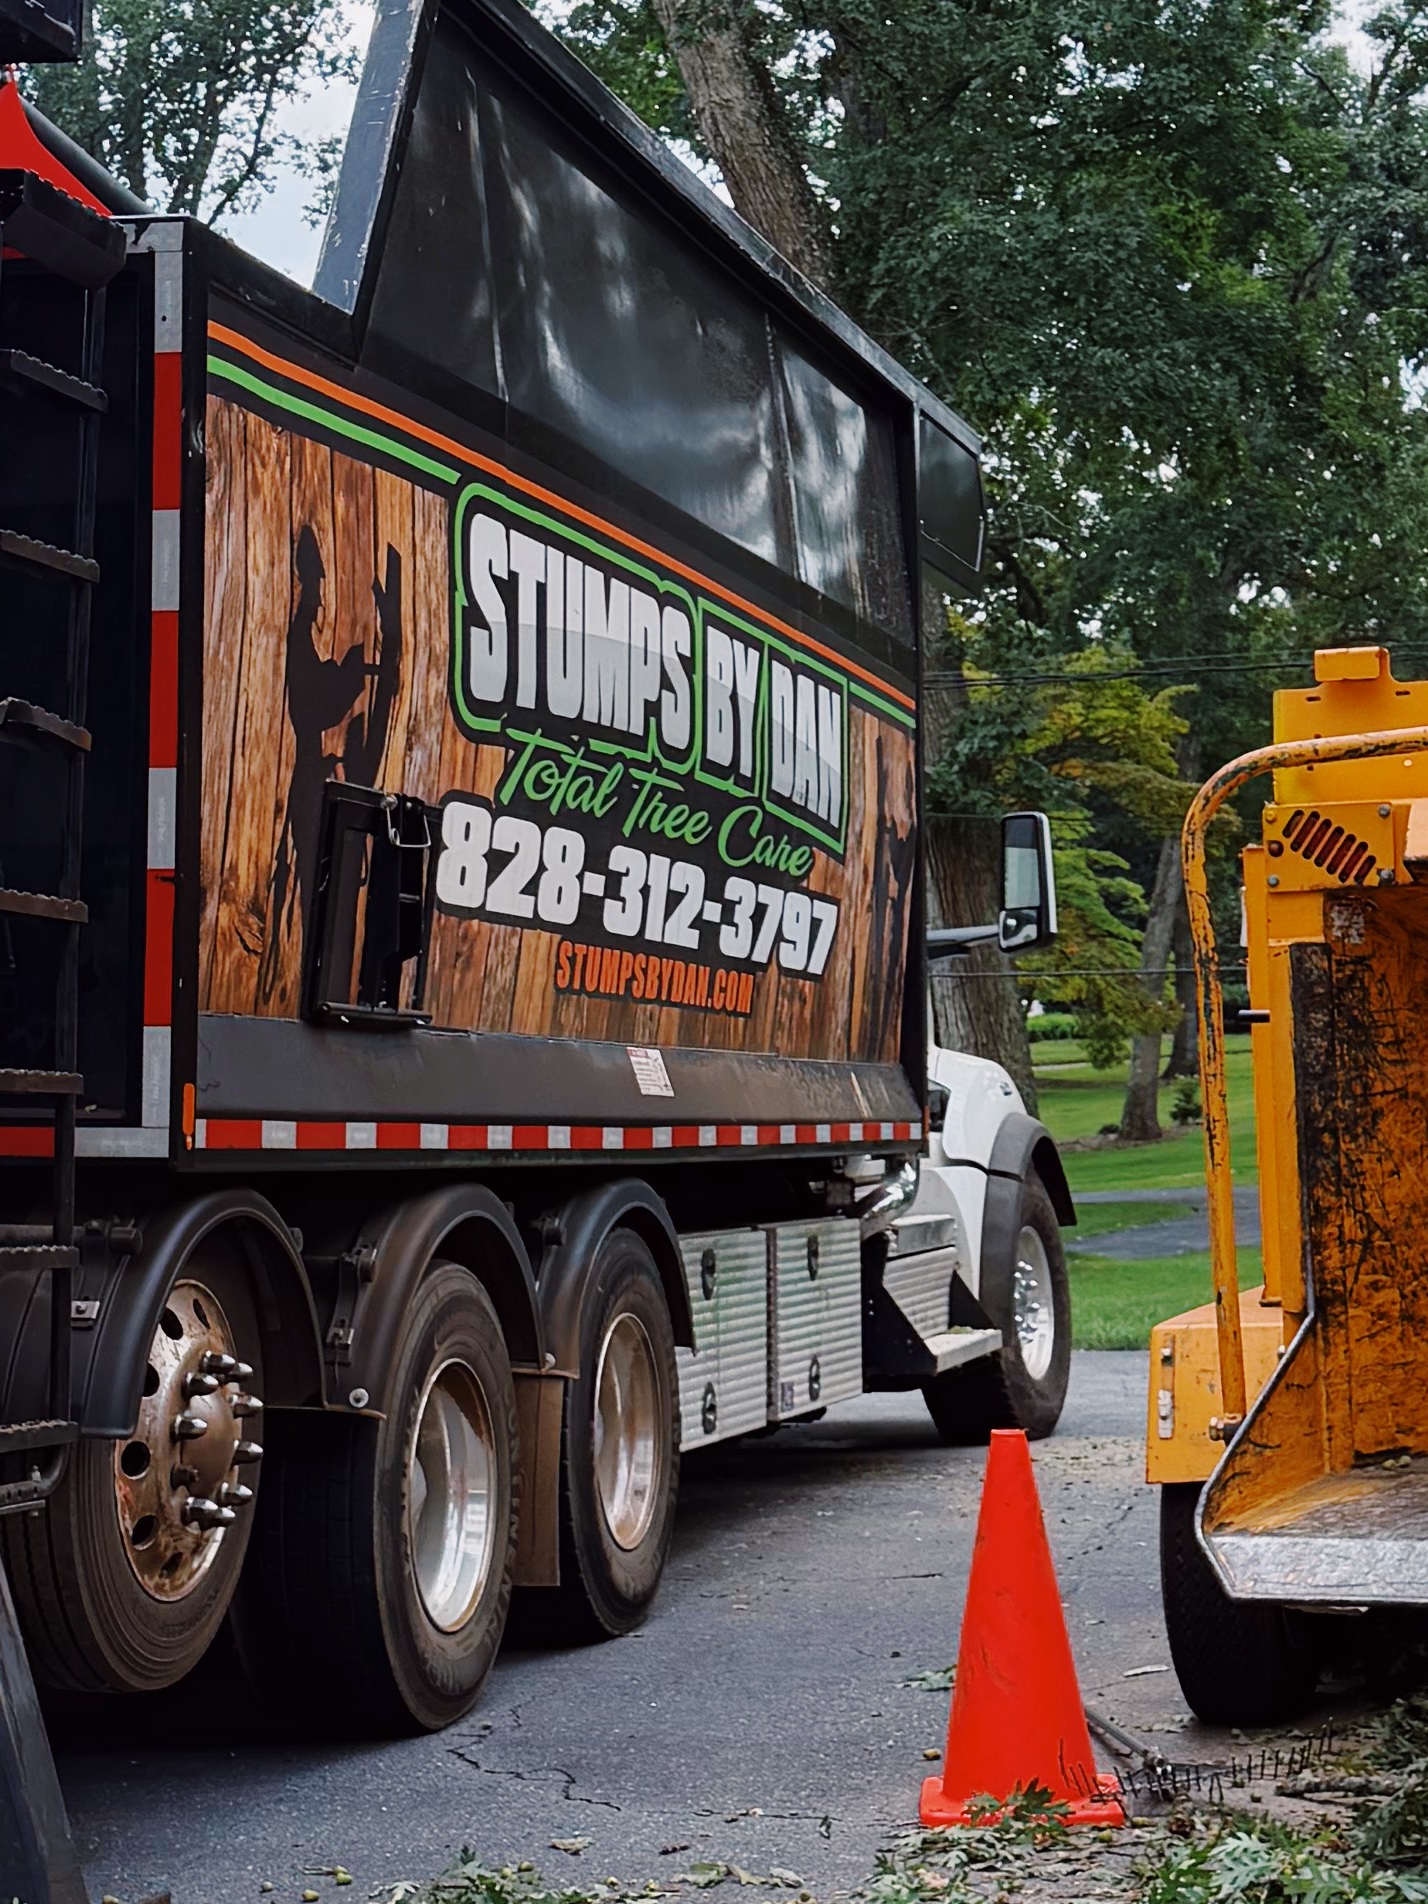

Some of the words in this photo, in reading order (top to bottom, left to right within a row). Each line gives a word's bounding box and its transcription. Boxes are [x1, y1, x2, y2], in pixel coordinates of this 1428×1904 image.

[470, 513, 692, 750] STUMPS
[707, 625, 761, 778] BY
[771, 659, 842, 829] DAN
[499, 728, 625, 819] Total
[621, 767, 712, 845] Tree
[718, 804, 815, 877] Care
[435, 800, 838, 976] 828-312-3797
[556, 940, 754, 1014] STUMPSBYDAN.COM
